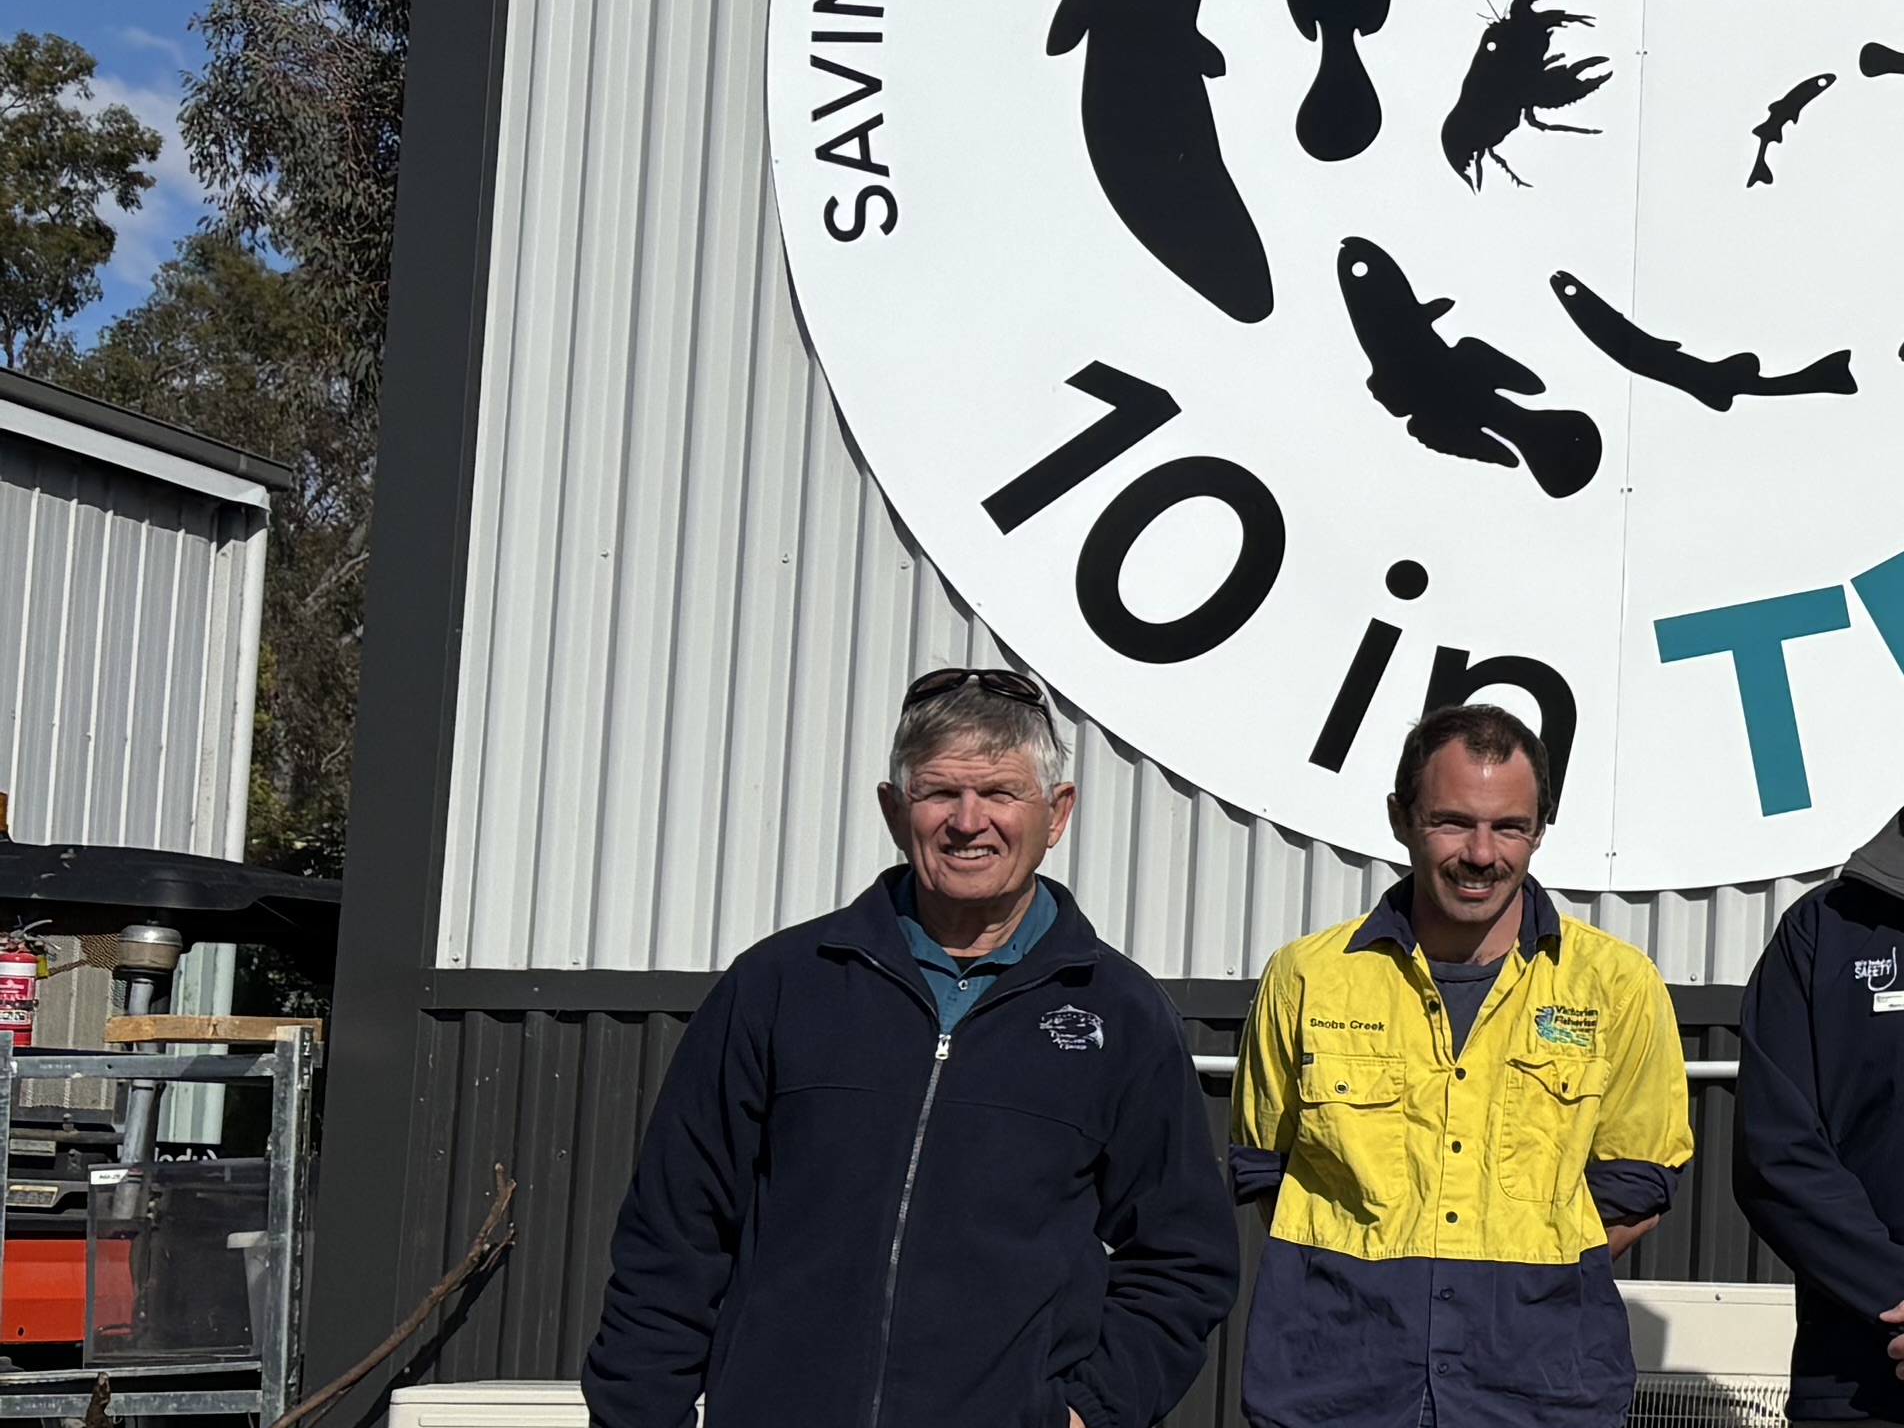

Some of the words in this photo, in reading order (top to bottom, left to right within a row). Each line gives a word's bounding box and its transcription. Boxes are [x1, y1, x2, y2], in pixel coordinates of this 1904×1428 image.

[980, 359, 1286, 665] 10
[1308, 559, 1578, 824] in
[1854, 963, 1892, 980] SAFETY
[1350, 1019, 1385, 1031] Creek
